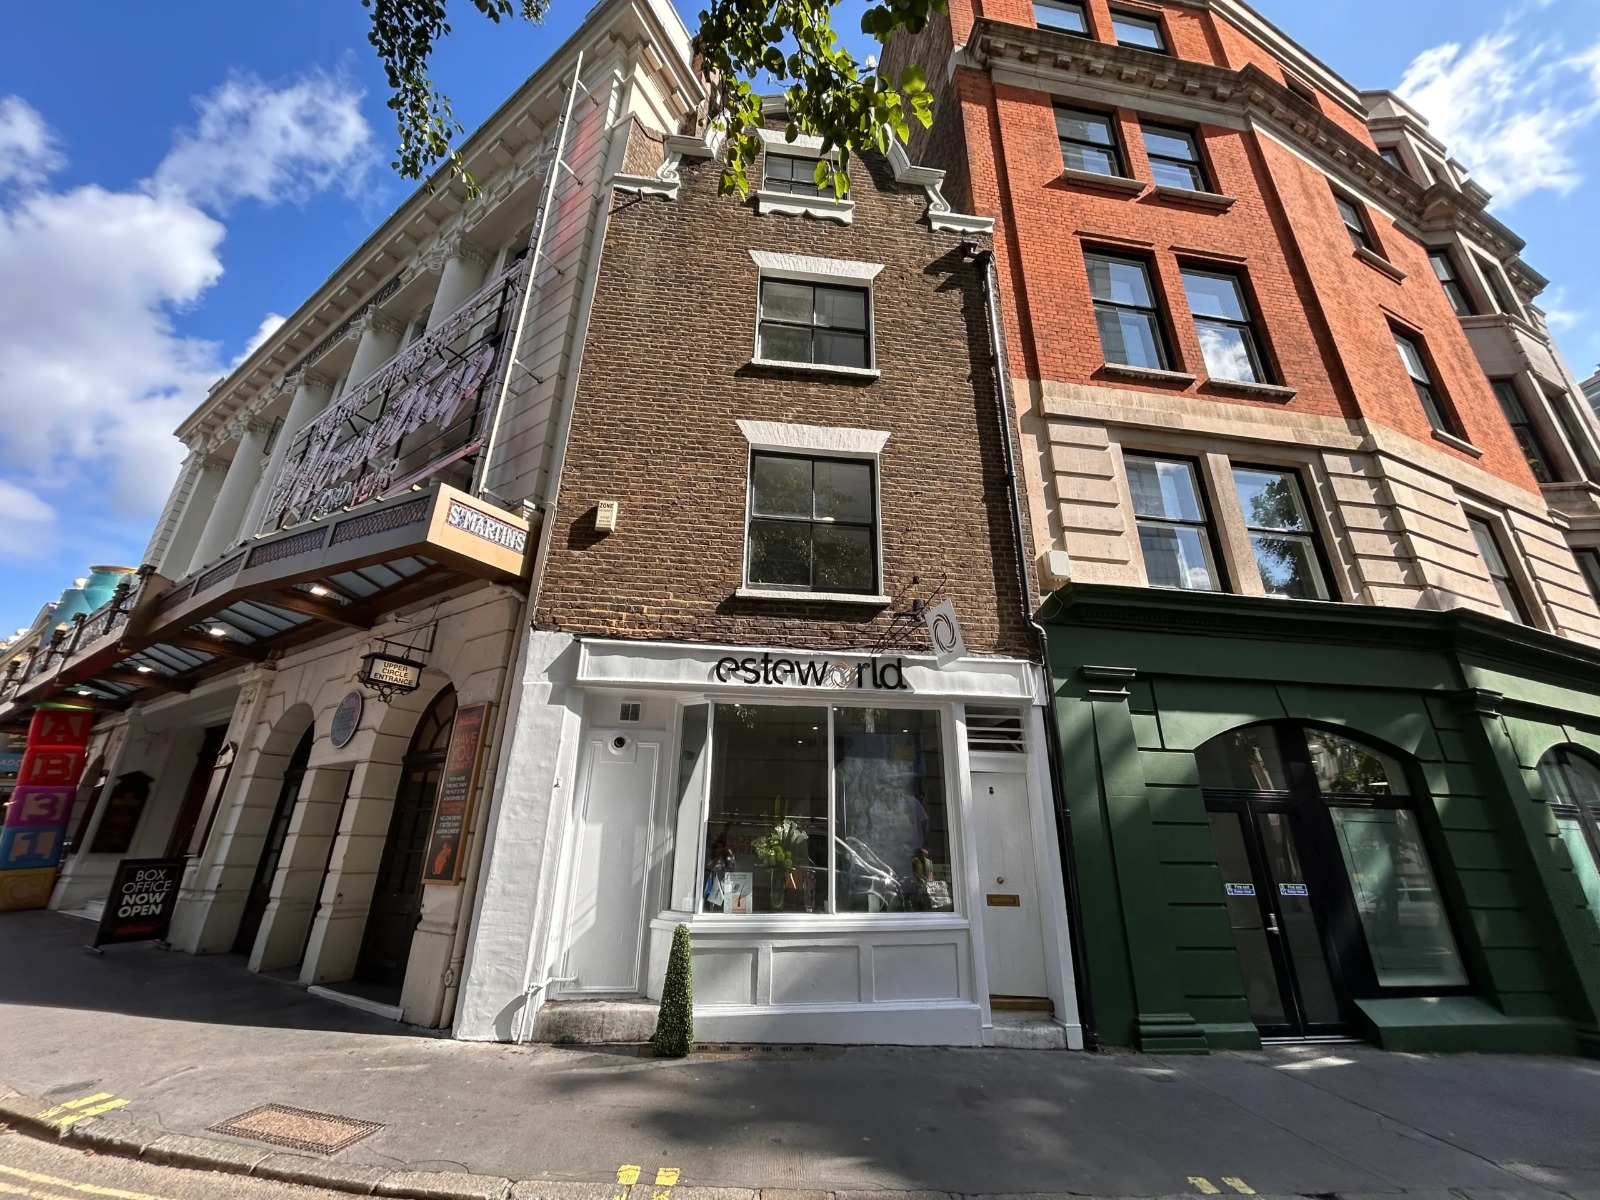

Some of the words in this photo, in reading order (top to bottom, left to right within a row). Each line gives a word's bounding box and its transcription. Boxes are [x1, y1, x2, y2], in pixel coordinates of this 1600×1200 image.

[382, 668, 408, 678] CIRCLE
[384, 662, 408, 672] UPPER
[716, 652, 908, 690] esteworld
[374, 672, 414, 686] ENTRANCE
[41, 715, 82, 742] A
[454, 732, 478, 745] HAVE
[450, 744, 476, 762] YOU
[32, 754, 72, 782] B
[28, 794, 59, 821] 3
[17, 831, 46, 862] 1
[136, 869, 168, 882] BOX
[122, 880, 172, 894] OFFICE
[121, 892, 167, 906] NOW
[117, 904, 162, 918] OPEN
